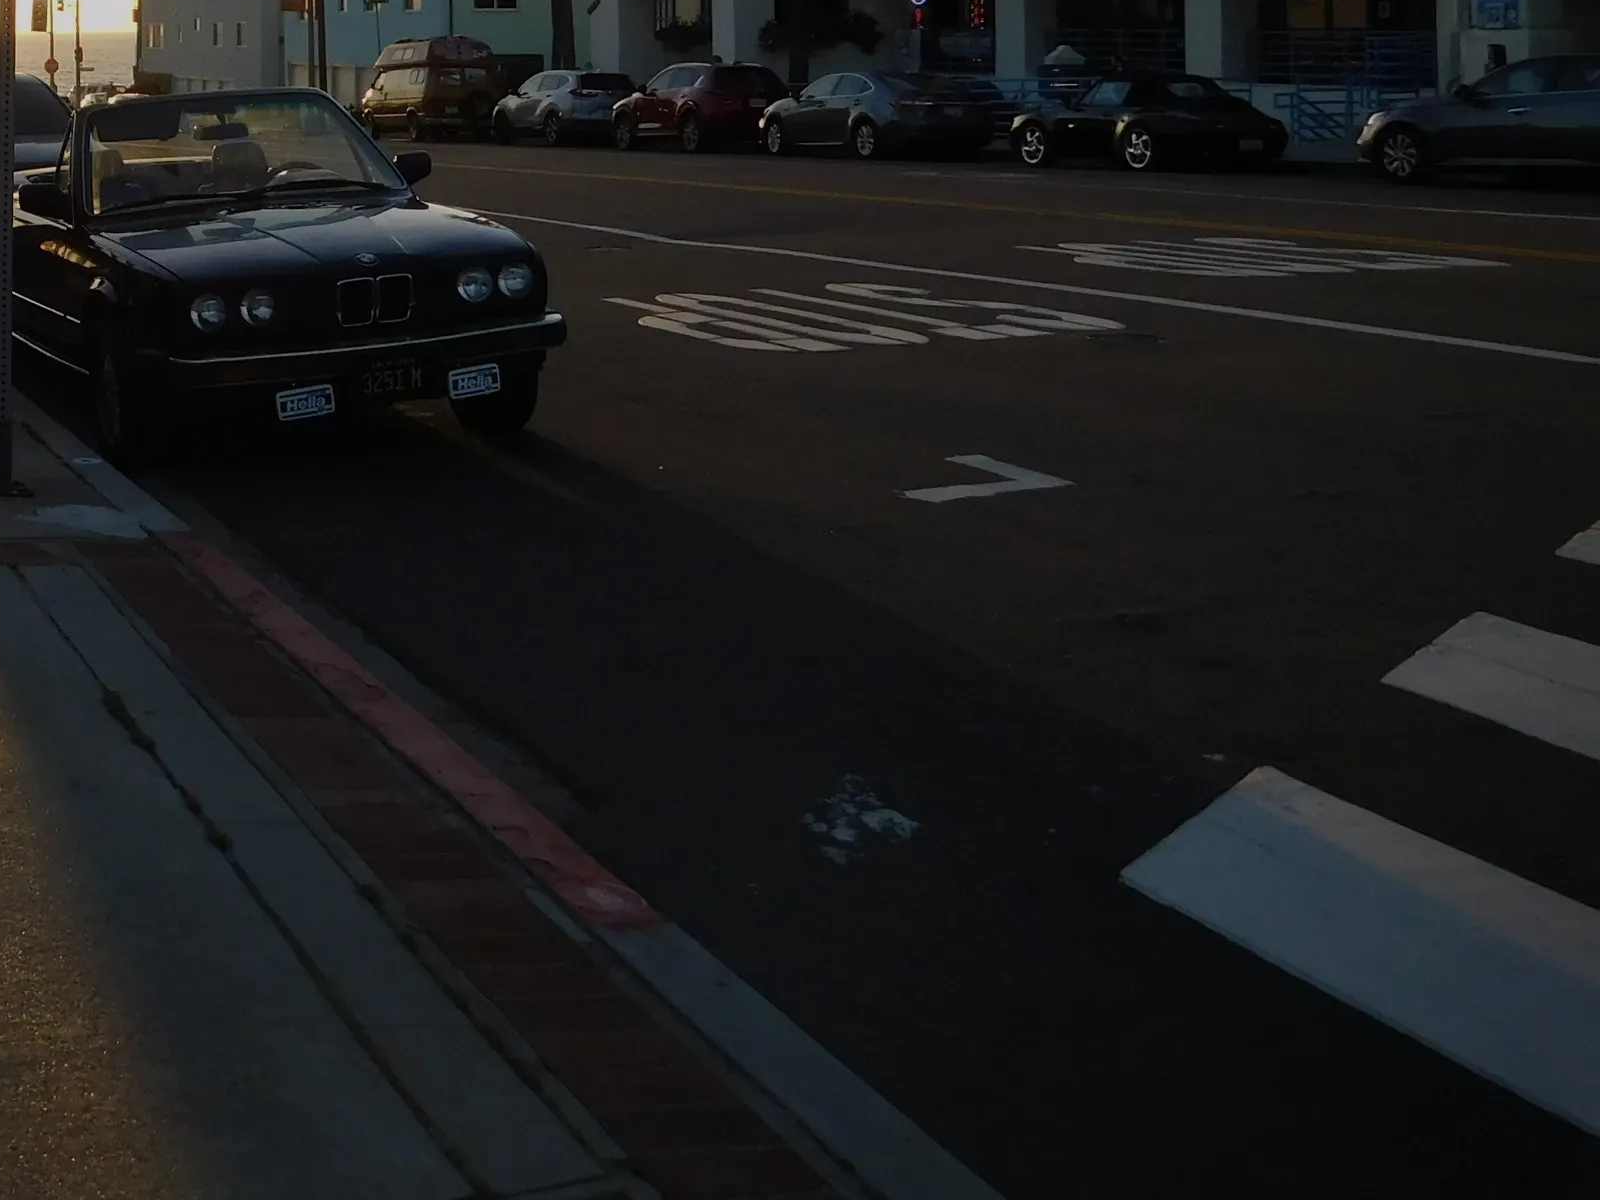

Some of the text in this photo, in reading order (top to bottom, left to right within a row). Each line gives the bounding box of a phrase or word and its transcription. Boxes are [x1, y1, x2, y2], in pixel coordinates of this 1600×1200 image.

[602, 282, 1126, 356] STOP
[457, 375, 493, 391] Hella
[286, 396, 326, 413] Hella
